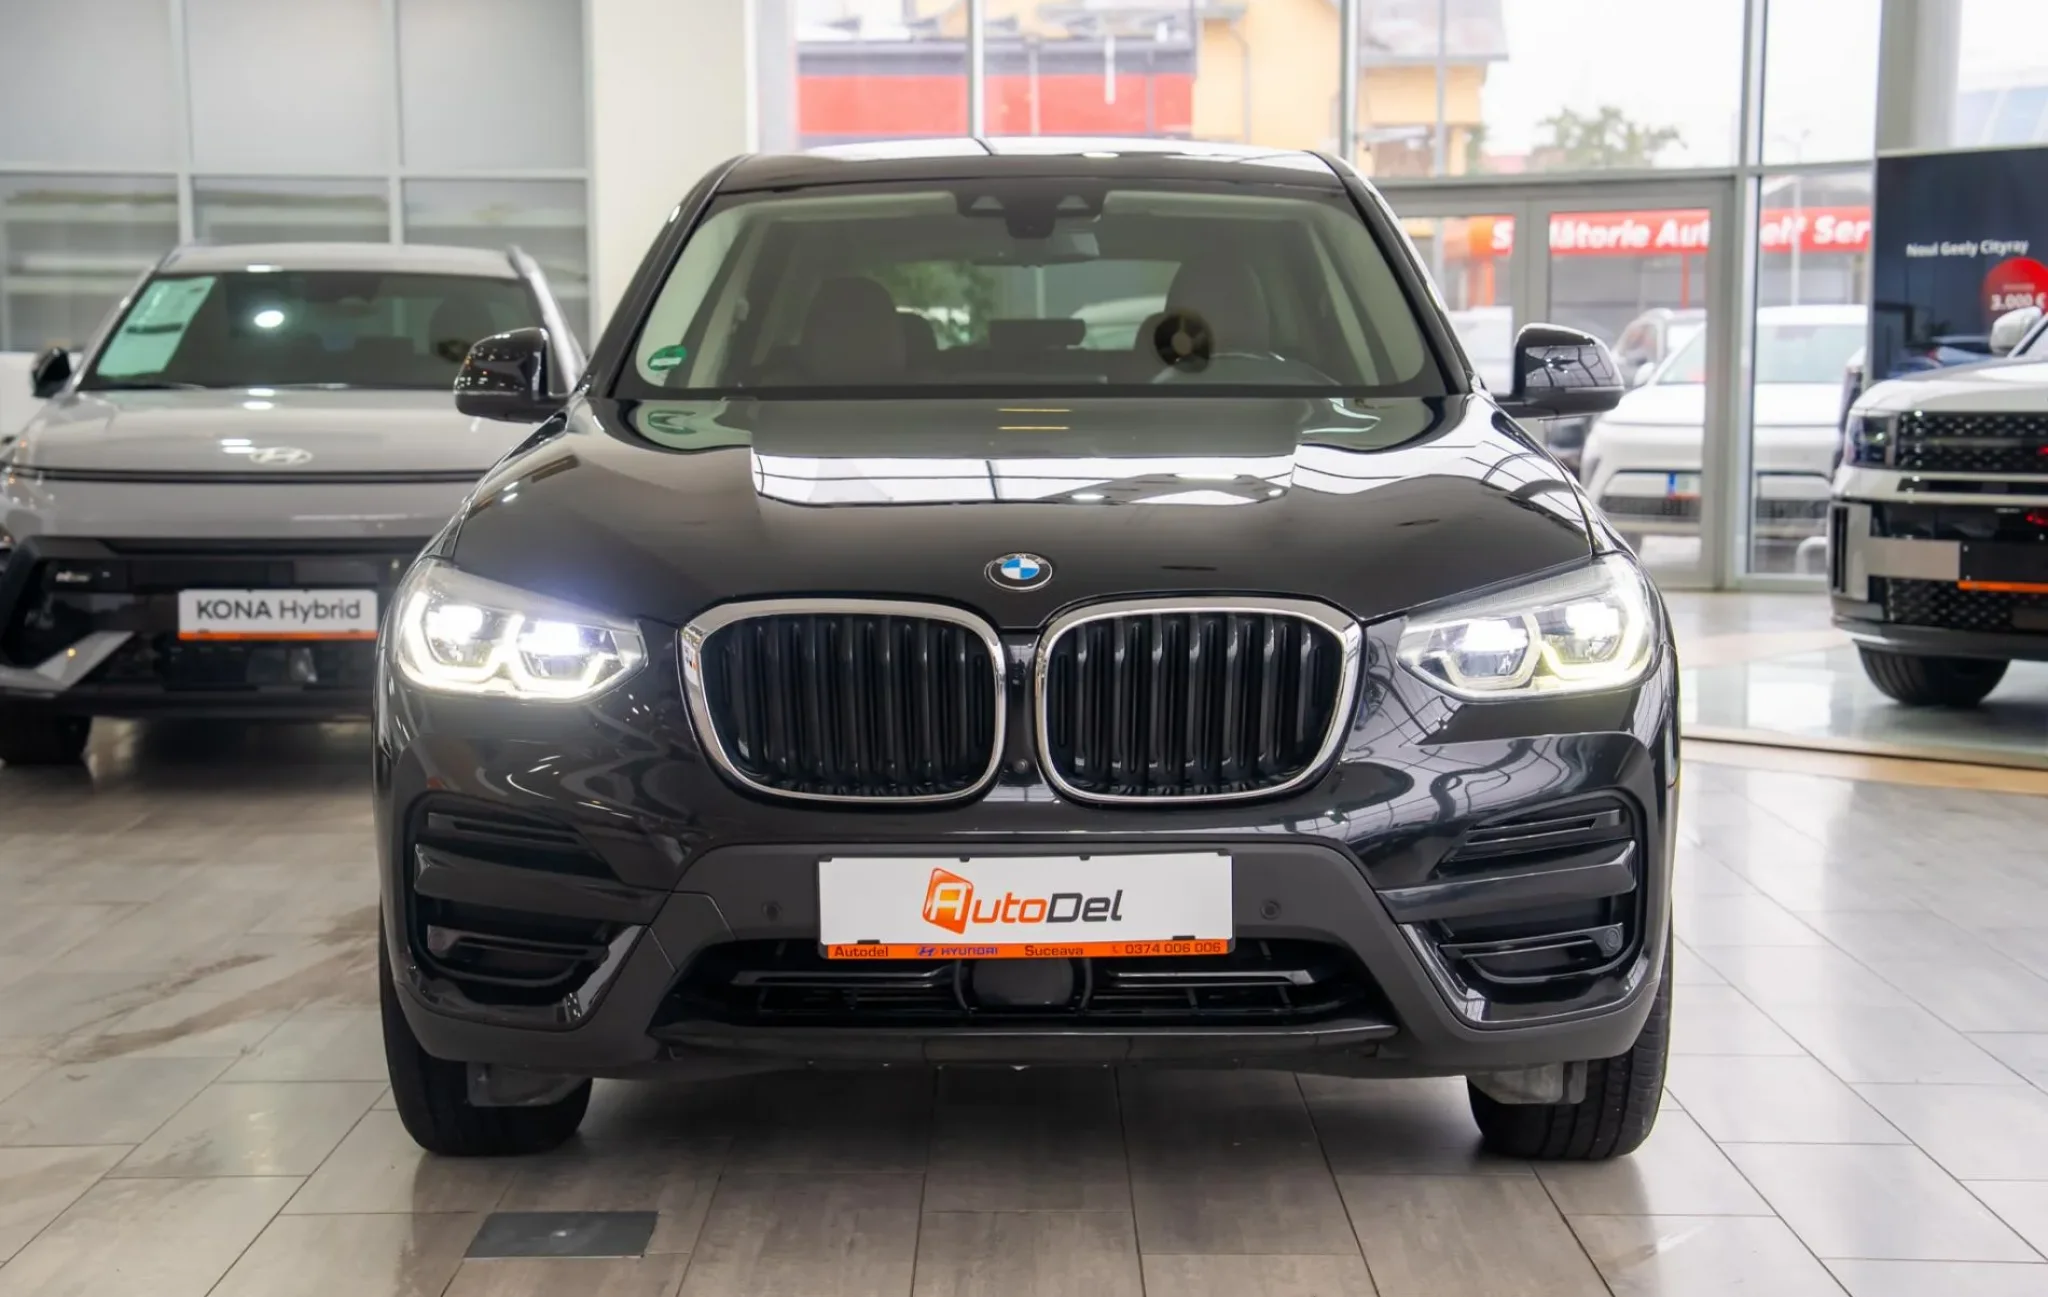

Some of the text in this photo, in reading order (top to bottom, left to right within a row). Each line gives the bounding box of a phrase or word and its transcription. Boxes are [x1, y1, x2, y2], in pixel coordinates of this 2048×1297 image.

[1655, 217, 1710, 248] Aut
[1813, 213, 1871, 245] Ser
[1940, 240, 1978, 258] Geely
[197, 598, 361, 624] KONA Hybrid
[926, 880, 1124, 925] AutoDel
[834, 941, 1221, 957] Autodel HYUNDAI Suceava 0374 006 006
